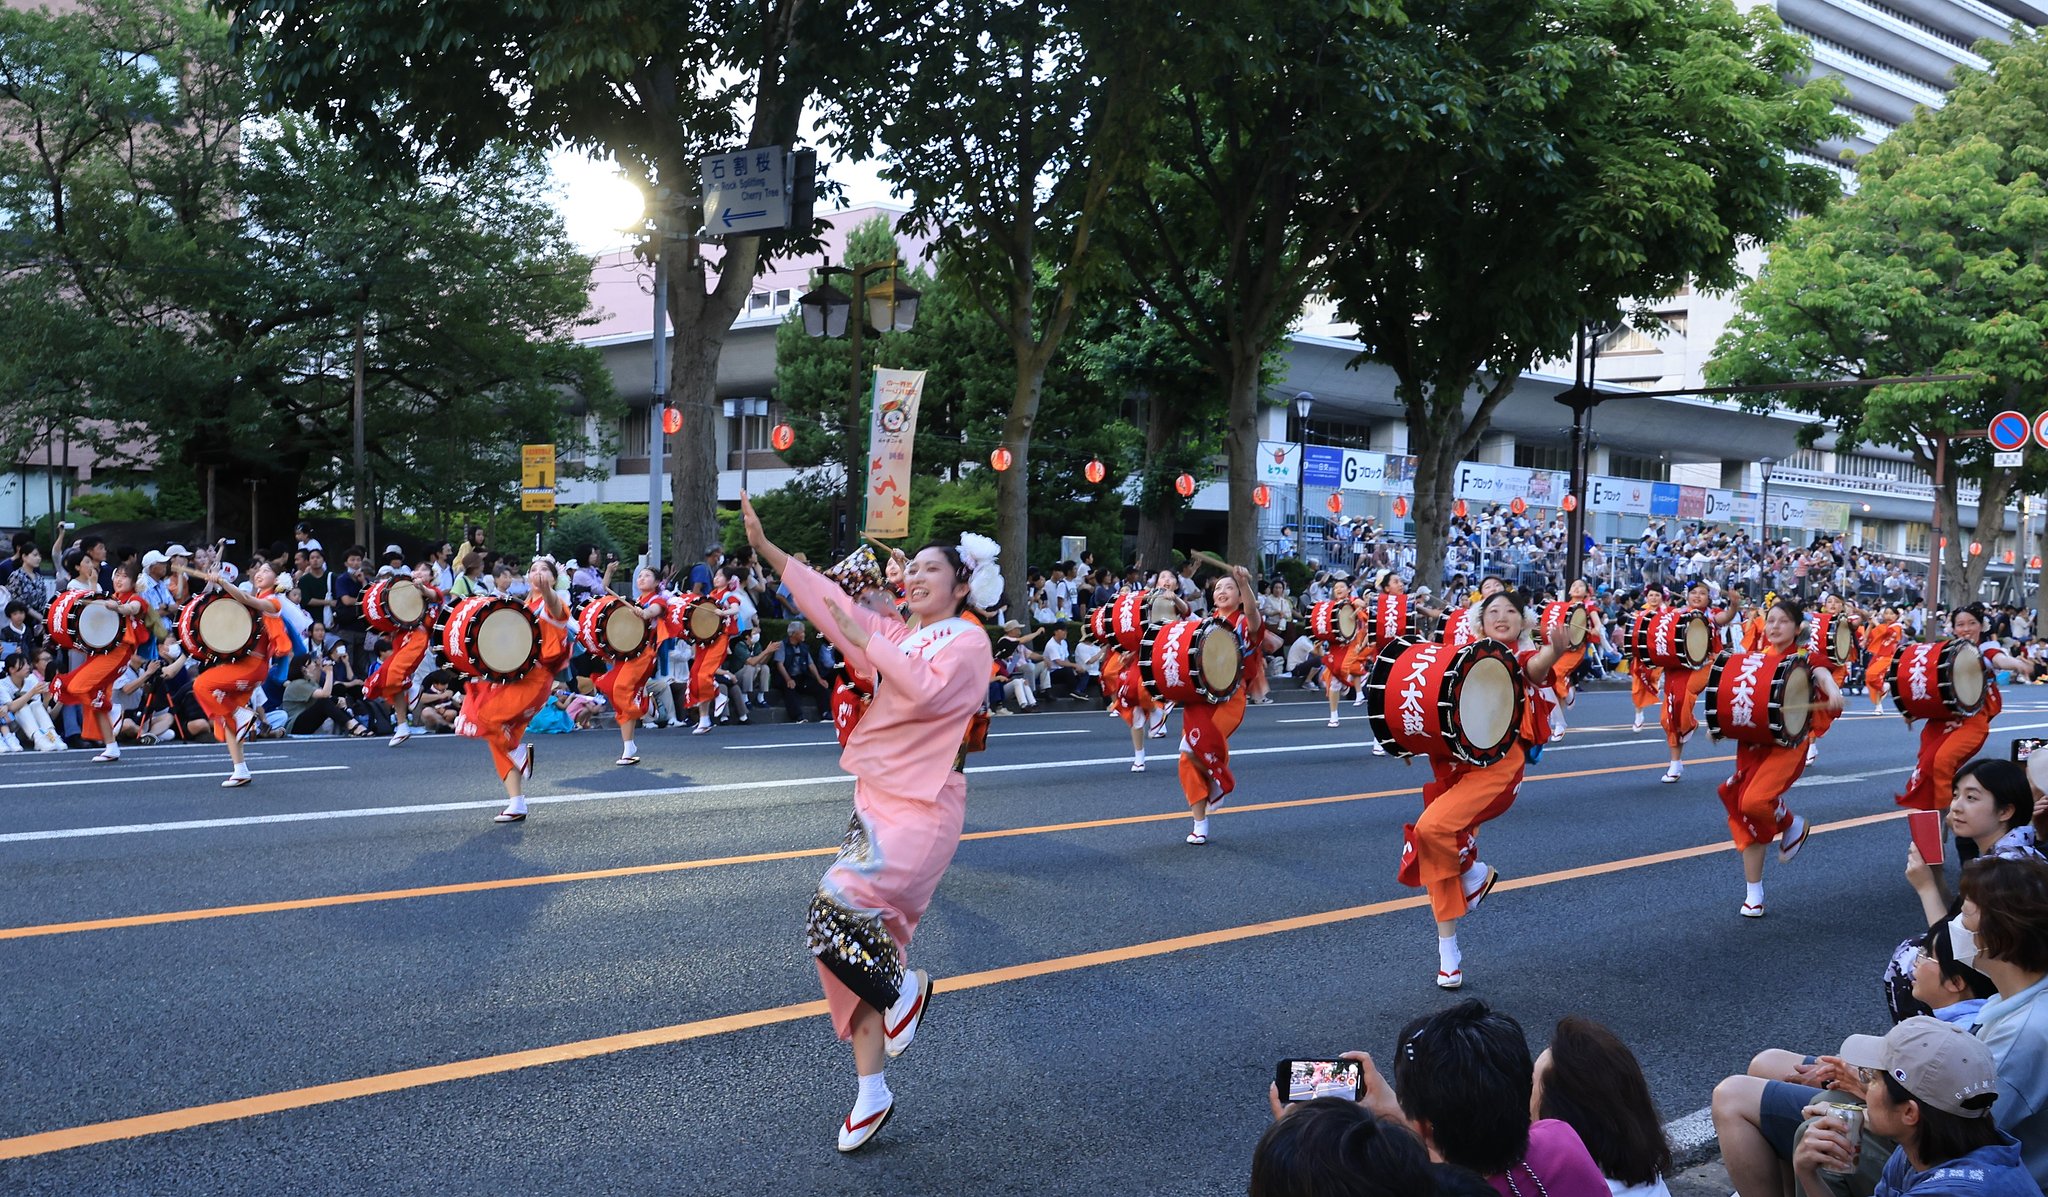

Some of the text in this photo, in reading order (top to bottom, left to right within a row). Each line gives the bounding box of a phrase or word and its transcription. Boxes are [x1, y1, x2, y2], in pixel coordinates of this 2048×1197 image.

[711, 152, 771, 179] 石割桜
[721, 181, 737, 191] Rock
[739, 177, 766, 189] Splitting
[741, 188, 779, 201] Cherry Tree
[1384, 595, 1399, 638] ミス太鼓
[1807, 617, 1821, 654] ミス太
[1161, 620, 1190, 687] ミス太鼓
[1398, 645, 1443, 738] ミス太鼓
[1730, 653, 1766, 729] ミス太鼓
